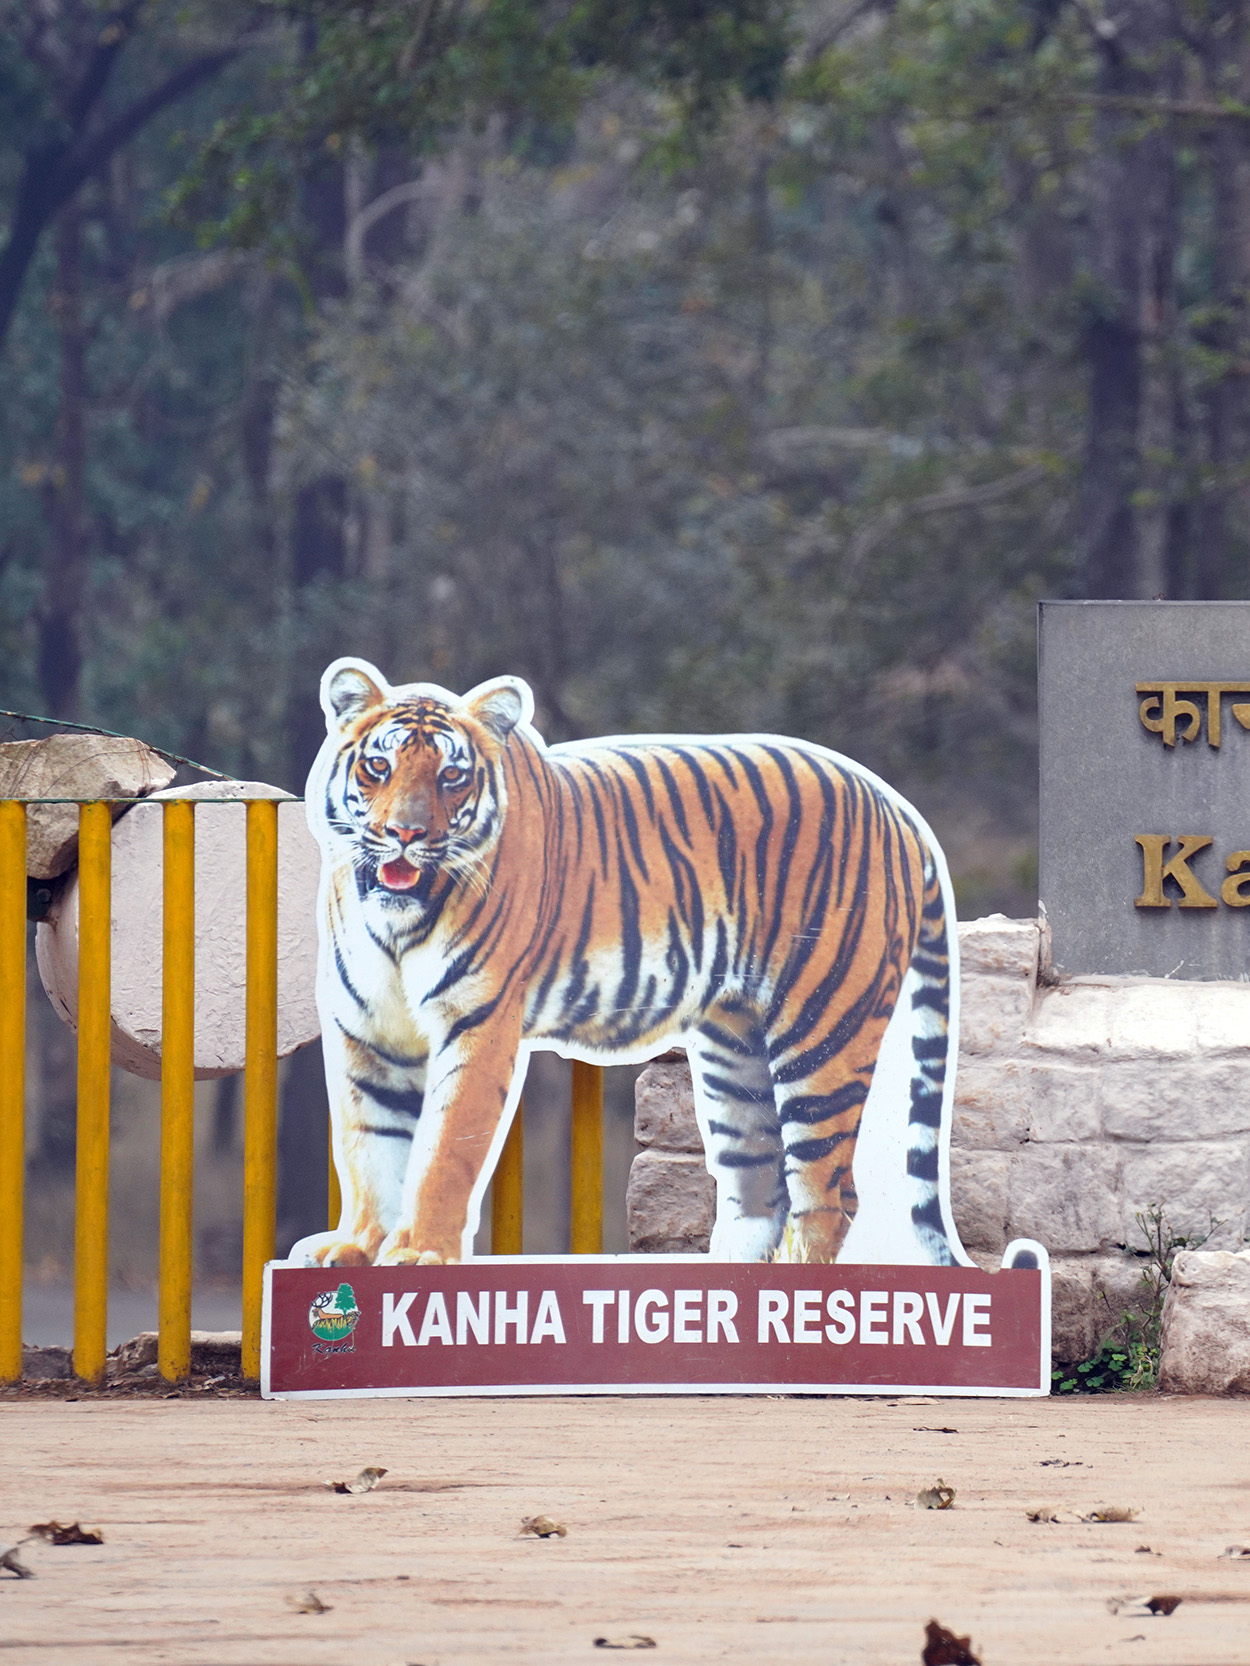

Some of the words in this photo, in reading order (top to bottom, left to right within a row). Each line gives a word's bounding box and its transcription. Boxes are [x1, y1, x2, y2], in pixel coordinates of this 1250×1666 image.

[381, 1289, 567, 1347] KANHA
[583, 1289, 740, 1345] TIGER
[758, 1289, 992, 1348] RESERVE
